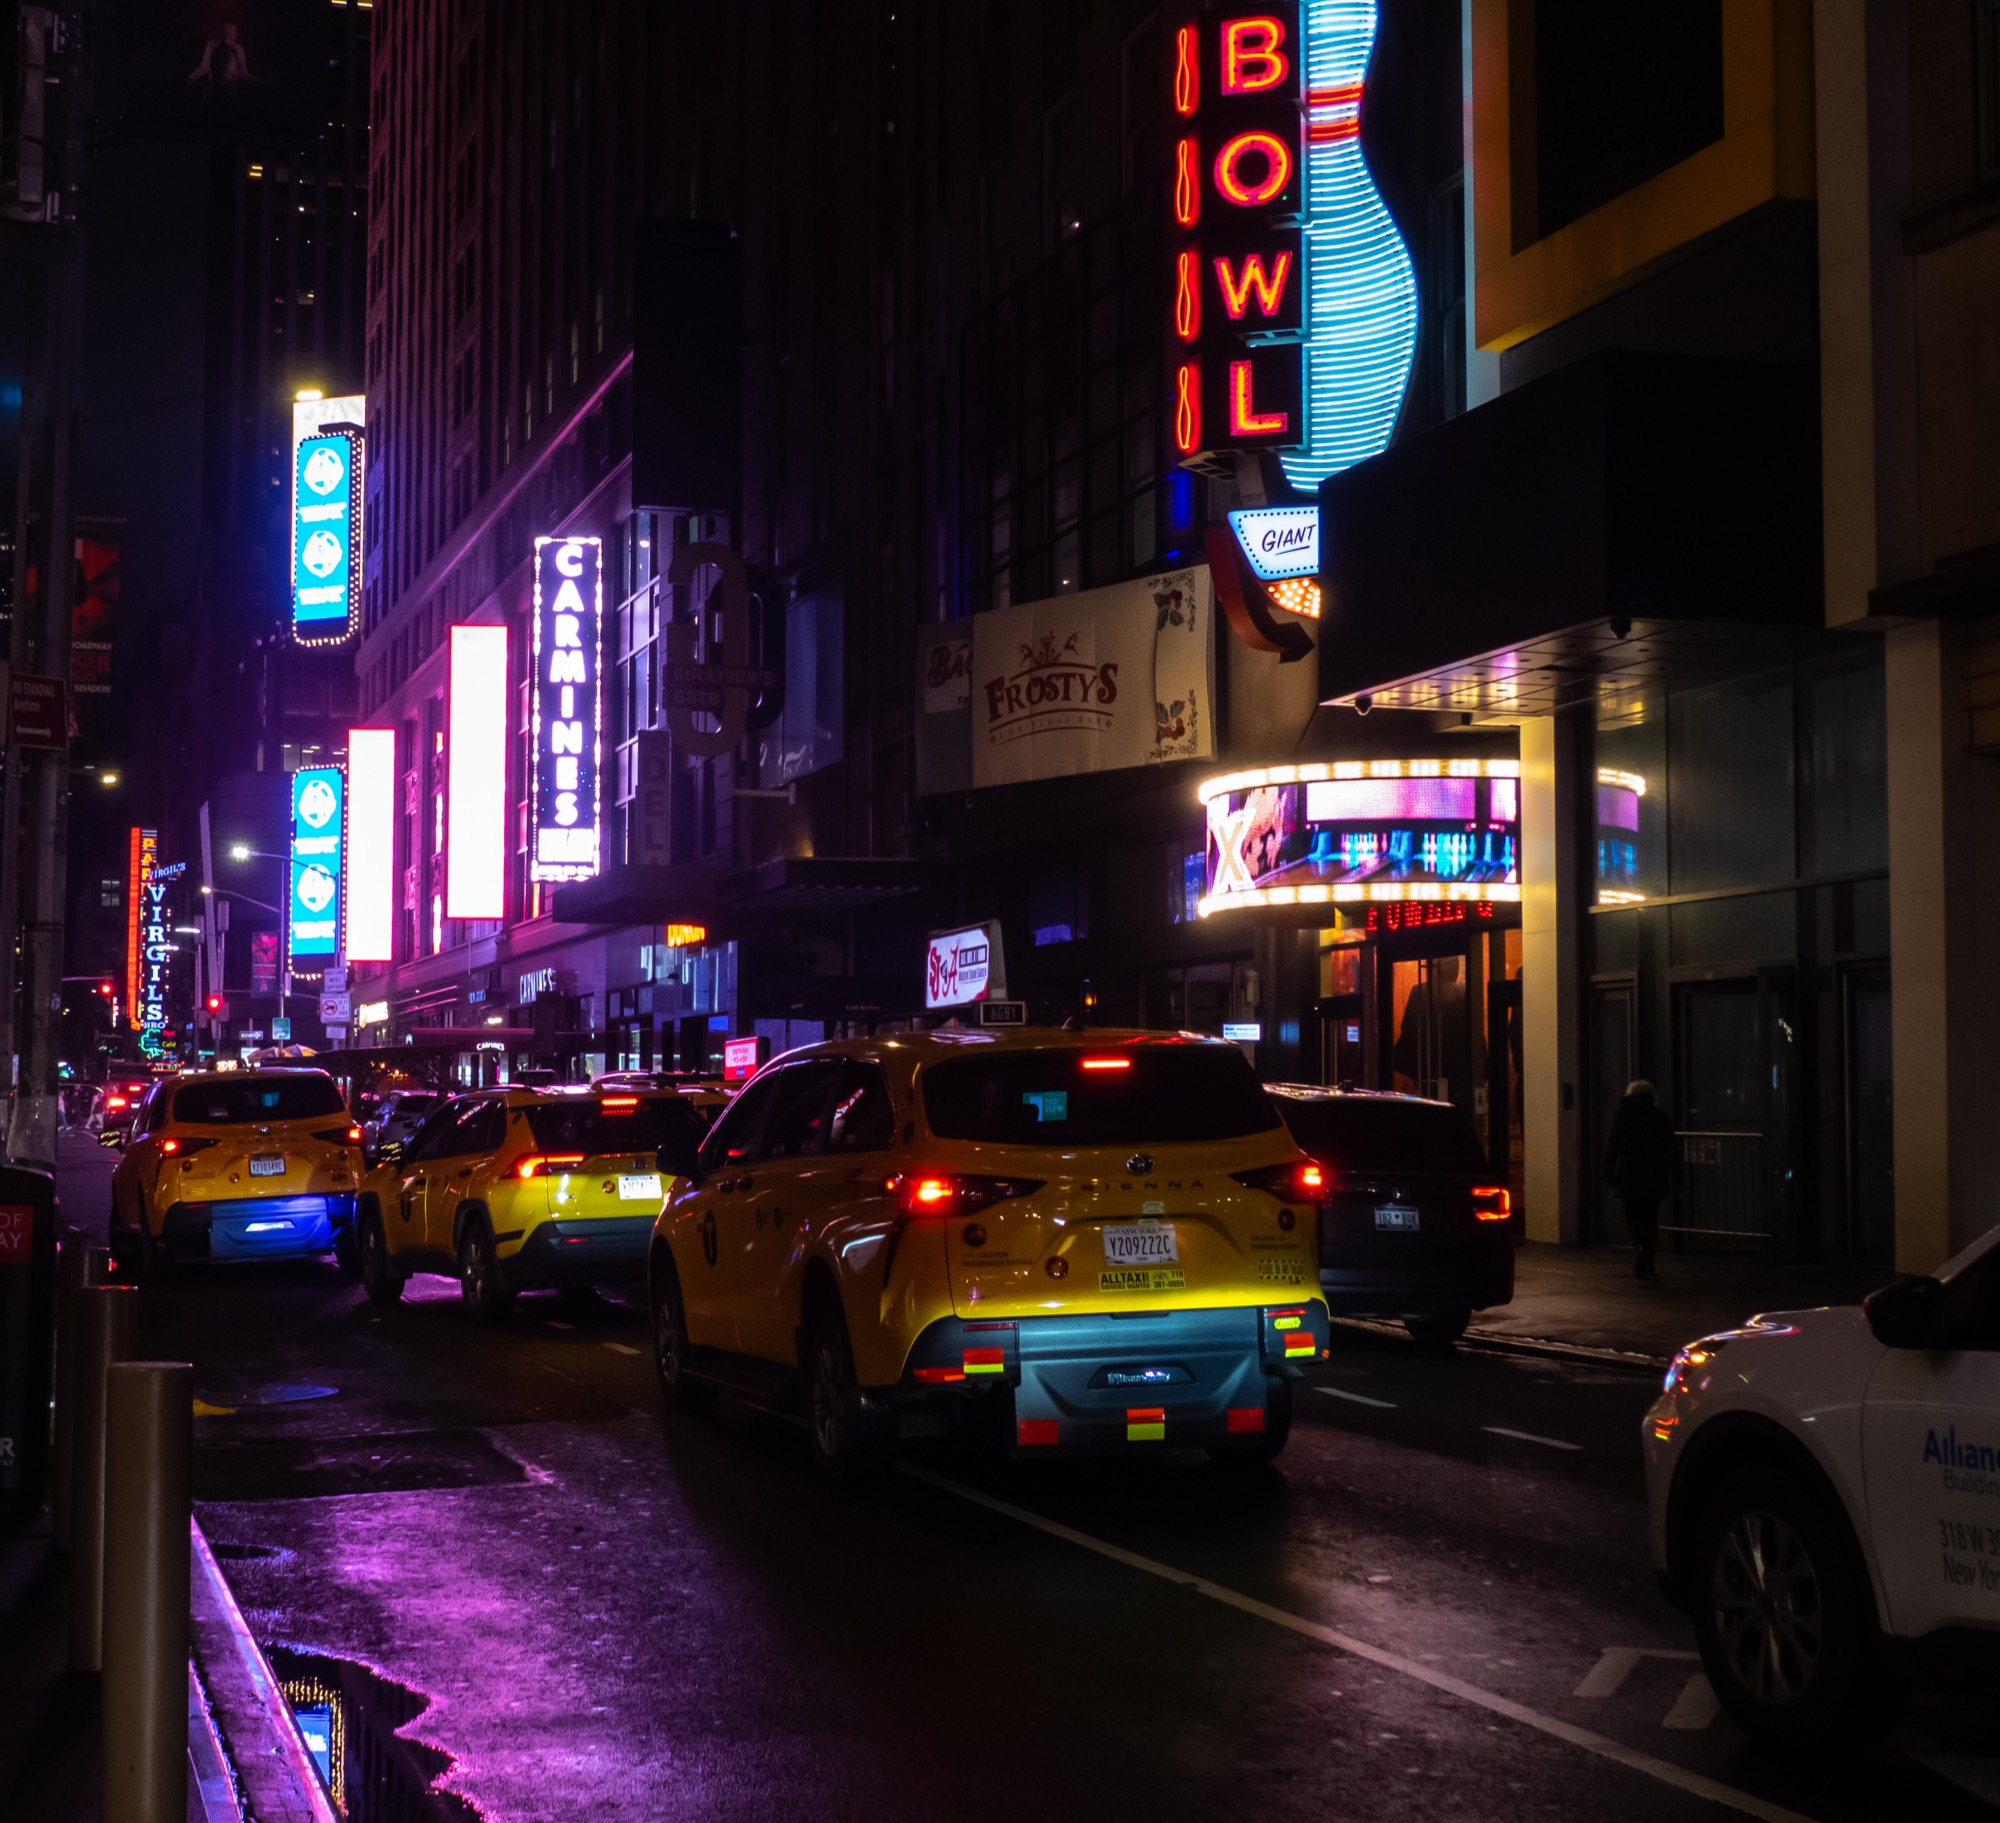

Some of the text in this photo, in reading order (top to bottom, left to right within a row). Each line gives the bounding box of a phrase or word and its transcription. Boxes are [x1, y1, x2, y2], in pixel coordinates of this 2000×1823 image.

[1212, 16, 1293, 437] BOWL
[1261, 523, 1317, 553] GIANT
[549, 544, 587, 827] CARMINES
[1080, 1180, 1206, 1192] SIENNA
[1924, 1425, 2000, 1472] Allian
[1938, 1519, 1966, 1550] 318
[1943, 1553, 1976, 1588] New
